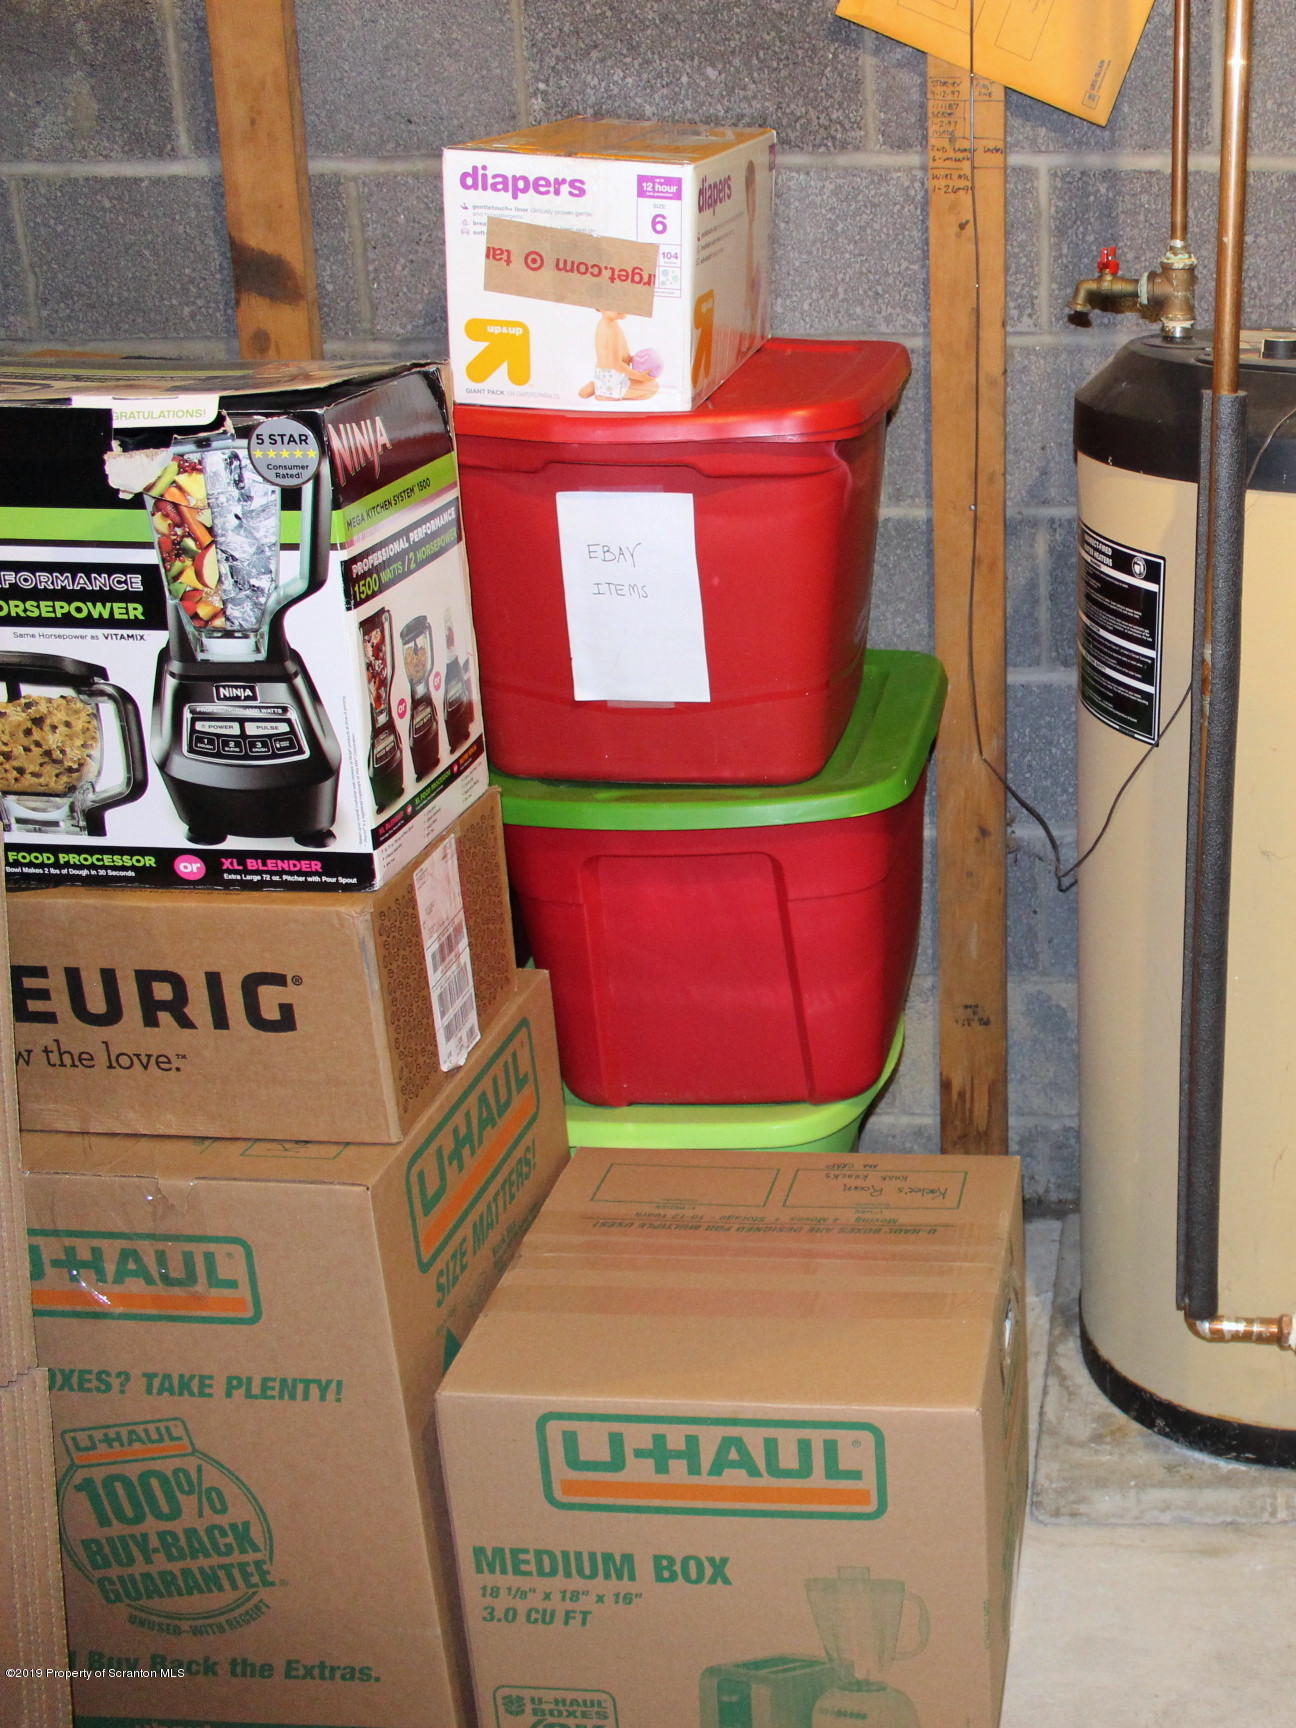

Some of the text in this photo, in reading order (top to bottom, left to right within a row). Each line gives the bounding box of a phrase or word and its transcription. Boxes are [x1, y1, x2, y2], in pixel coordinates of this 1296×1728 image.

[459, 164, 587, 200] diapers
[641, 182, 678, 193] 12 hour
[697, 174, 732, 216] diapers
[650, 213, 668, 235] 6
[554, 260, 656, 287] rget.com
[487, 388, 505, 396] PACK
[255, 433, 309, 446] 5 STAR
[327, 416, 393, 487] NINJA
[266, 462, 310, 471] Consumer
[275, 471, 304, 480] Rated!
[346, 477, 431, 531] MEGA KITCHEN SYSTEM 1500
[352, 507, 457, 578] PROFESSIONAL PERFORMANCE
[586, 542, 642, 568] EBAY
[354, 572, 380, 602] 1500
[380, 560, 403, 584] WATTS
[409, 552, 417, 570] 2
[416, 527, 458, 562] HORSEPOWER
[0, 571, 144, 592] FORMANCE
[592, 582, 649, 599] ITEMS
[13, 631, 37, 639] Same
[38, 632, 88, 641] Horsepower
[102, 632, 147, 642] VITAMIX
[219, 686, 254, 700] NINJA
[7, 851, 157, 867] FOOD PROCESSOR
[178, 862, 200, 873] or
[219, 858, 323, 872] XL BLENDER
[69, 868, 90, 877] Dough
[107, 869, 136, 877] Seconds
[242, 874, 262, 882] Large
[283, 874, 306, 882] Pitcher
[306, 875, 321, 883] with
[338, 876, 358, 885] Spout
[41, 1039, 96, 1069] the
[416, 1047, 531, 1217] U-HAUL
[435, 1235, 469, 1309] SIZE
[472, 1136, 537, 1257] MATTERS!
[142, 1372, 214, 1398] TAKE
[225, 1375, 344, 1403] PLENTY!
[71, 1424, 184, 1452] U-HAUL
[74, 1463, 230, 1528] 100%
[80, 1520, 263, 1571] BUY-BACK
[472, 1545, 733, 1586] MEDIUM BOX
[98, 1559, 277, 1604] GUARANTEE
[479, 1585, 501, 1599] 18
[542, 1590, 552, 1602] x
[594, 1593, 606, 1605] x
[226, 1598, 271, 1633] RECEIPT
[482, 1604, 593, 1628] 3.0 CU FT
[150, 1652, 219, 1677] Back
[229, 1656, 275, 1680] the
[284, 1659, 381, 1683] Extras.
[529, 1697, 608, 1709] U-HAUL
[531, 1707, 609, 1720] BOXES
